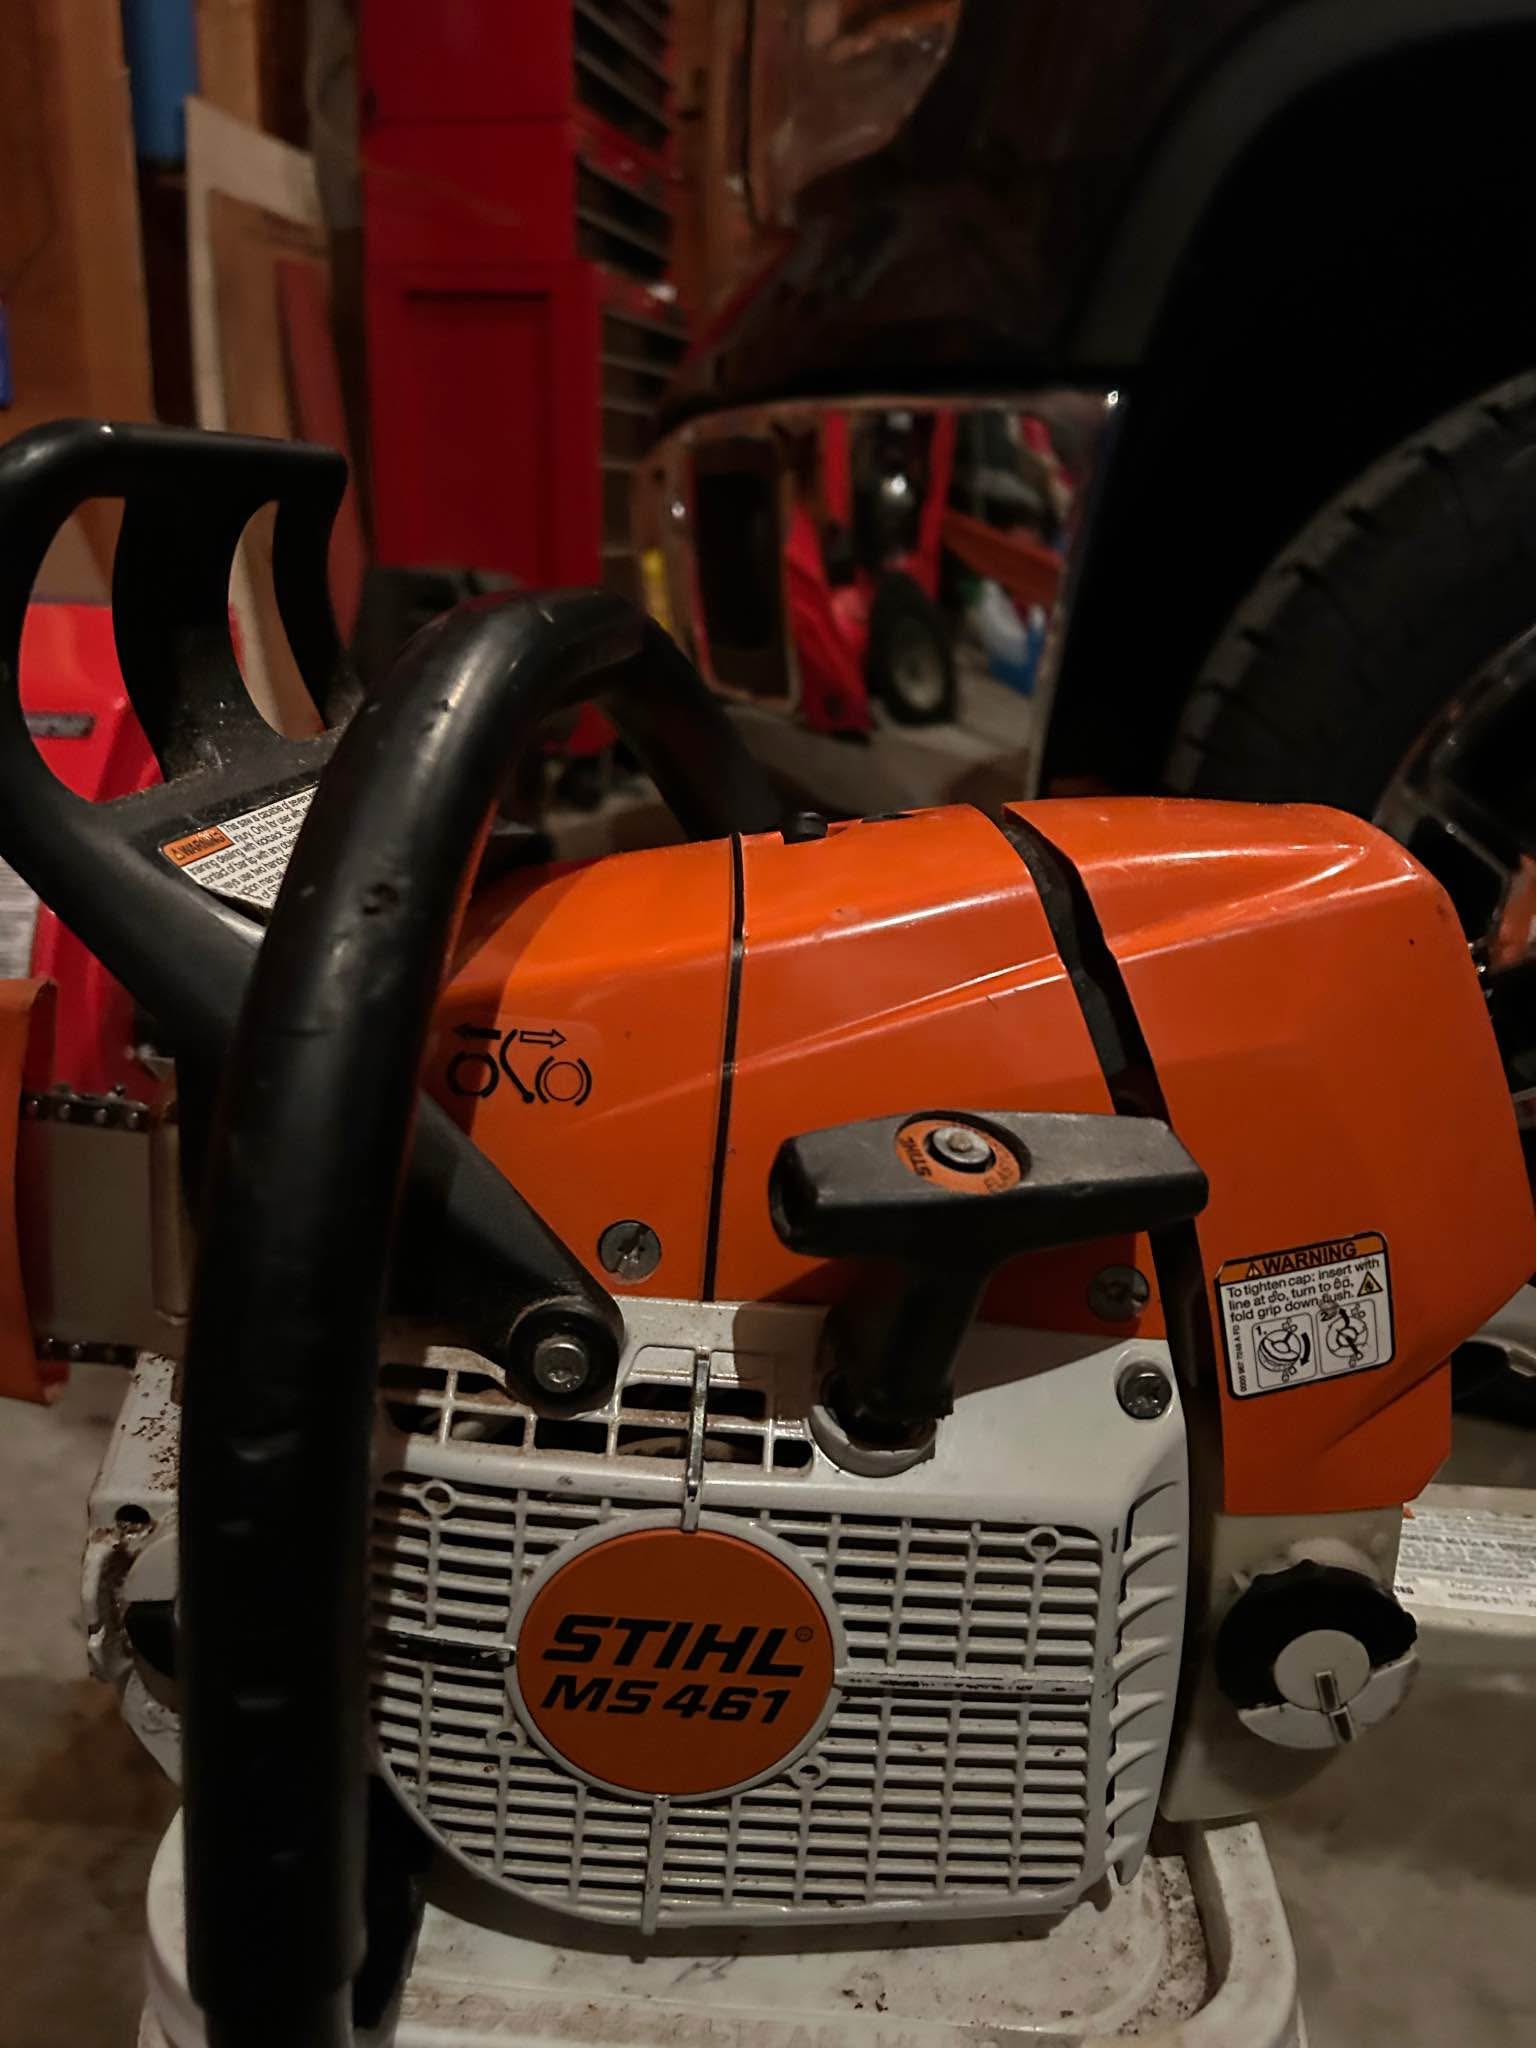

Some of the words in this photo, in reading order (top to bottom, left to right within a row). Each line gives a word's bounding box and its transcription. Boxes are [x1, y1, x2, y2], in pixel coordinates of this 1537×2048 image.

[1263, 1242, 1357, 1274] WARNING
[1226, 1287, 1242, 1298] To
[1244, 1279, 1286, 1296] tighten
[1288, 1273, 1315, 1286] cap:
[1318, 1264, 1352, 1280] insert
[1355, 1258, 1380, 1272] with
[1229, 1299, 1251, 1310] line
[1254, 1295, 1265, 1306] at
[1291, 1286, 1316, 1298] turn
[1319, 1282, 1331, 1292] to
[1230, 1309, 1254, 1322] fold
[1258, 1304, 1281, 1320] grip
[1285, 1298, 1319, 1312] down
[542, 1614, 804, 1678] STIHL
[541, 1674, 659, 1715] MS
[662, 1684, 791, 1724] 461
